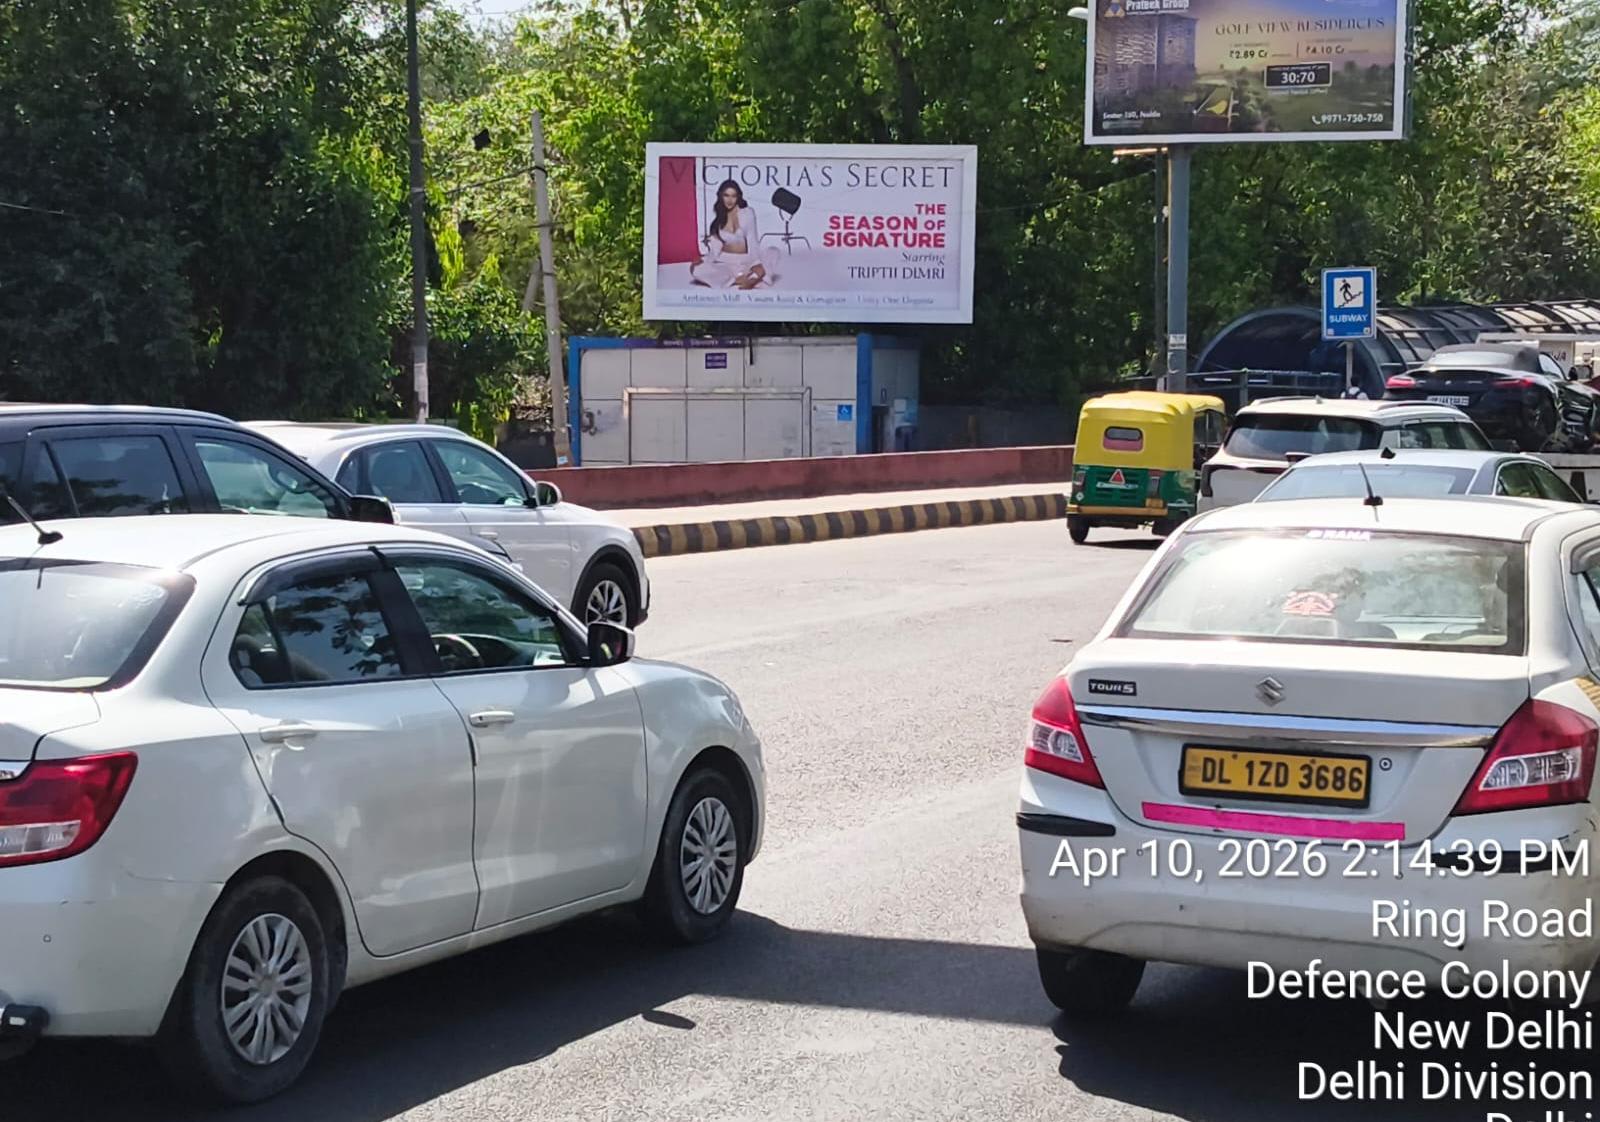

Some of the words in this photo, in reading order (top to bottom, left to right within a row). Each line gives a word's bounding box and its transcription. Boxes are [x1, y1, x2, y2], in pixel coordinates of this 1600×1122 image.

[1162, 0, 1189, 11] Group
[1258, 21, 1291, 33] VIEW
[1297, 17, 1385, 32] RESIDENCES
[1281, 71, 1316, 84] 30:70
[847, 163, 955, 188] SECRET
[914, 204, 947, 215] THE
[829, 215, 918, 230] SEASON
[924, 219, 946, 231] OF
[823, 232, 946, 248] SIGNATURE
[902, 252, 946, 266] Starring
[1329, 313, 1369, 323] SUBWAY
[1201, 756, 1232, 785] DL
[1246, 760, 1290, 788] 1ZD
[1298, 763, 1363, 793] 3686
